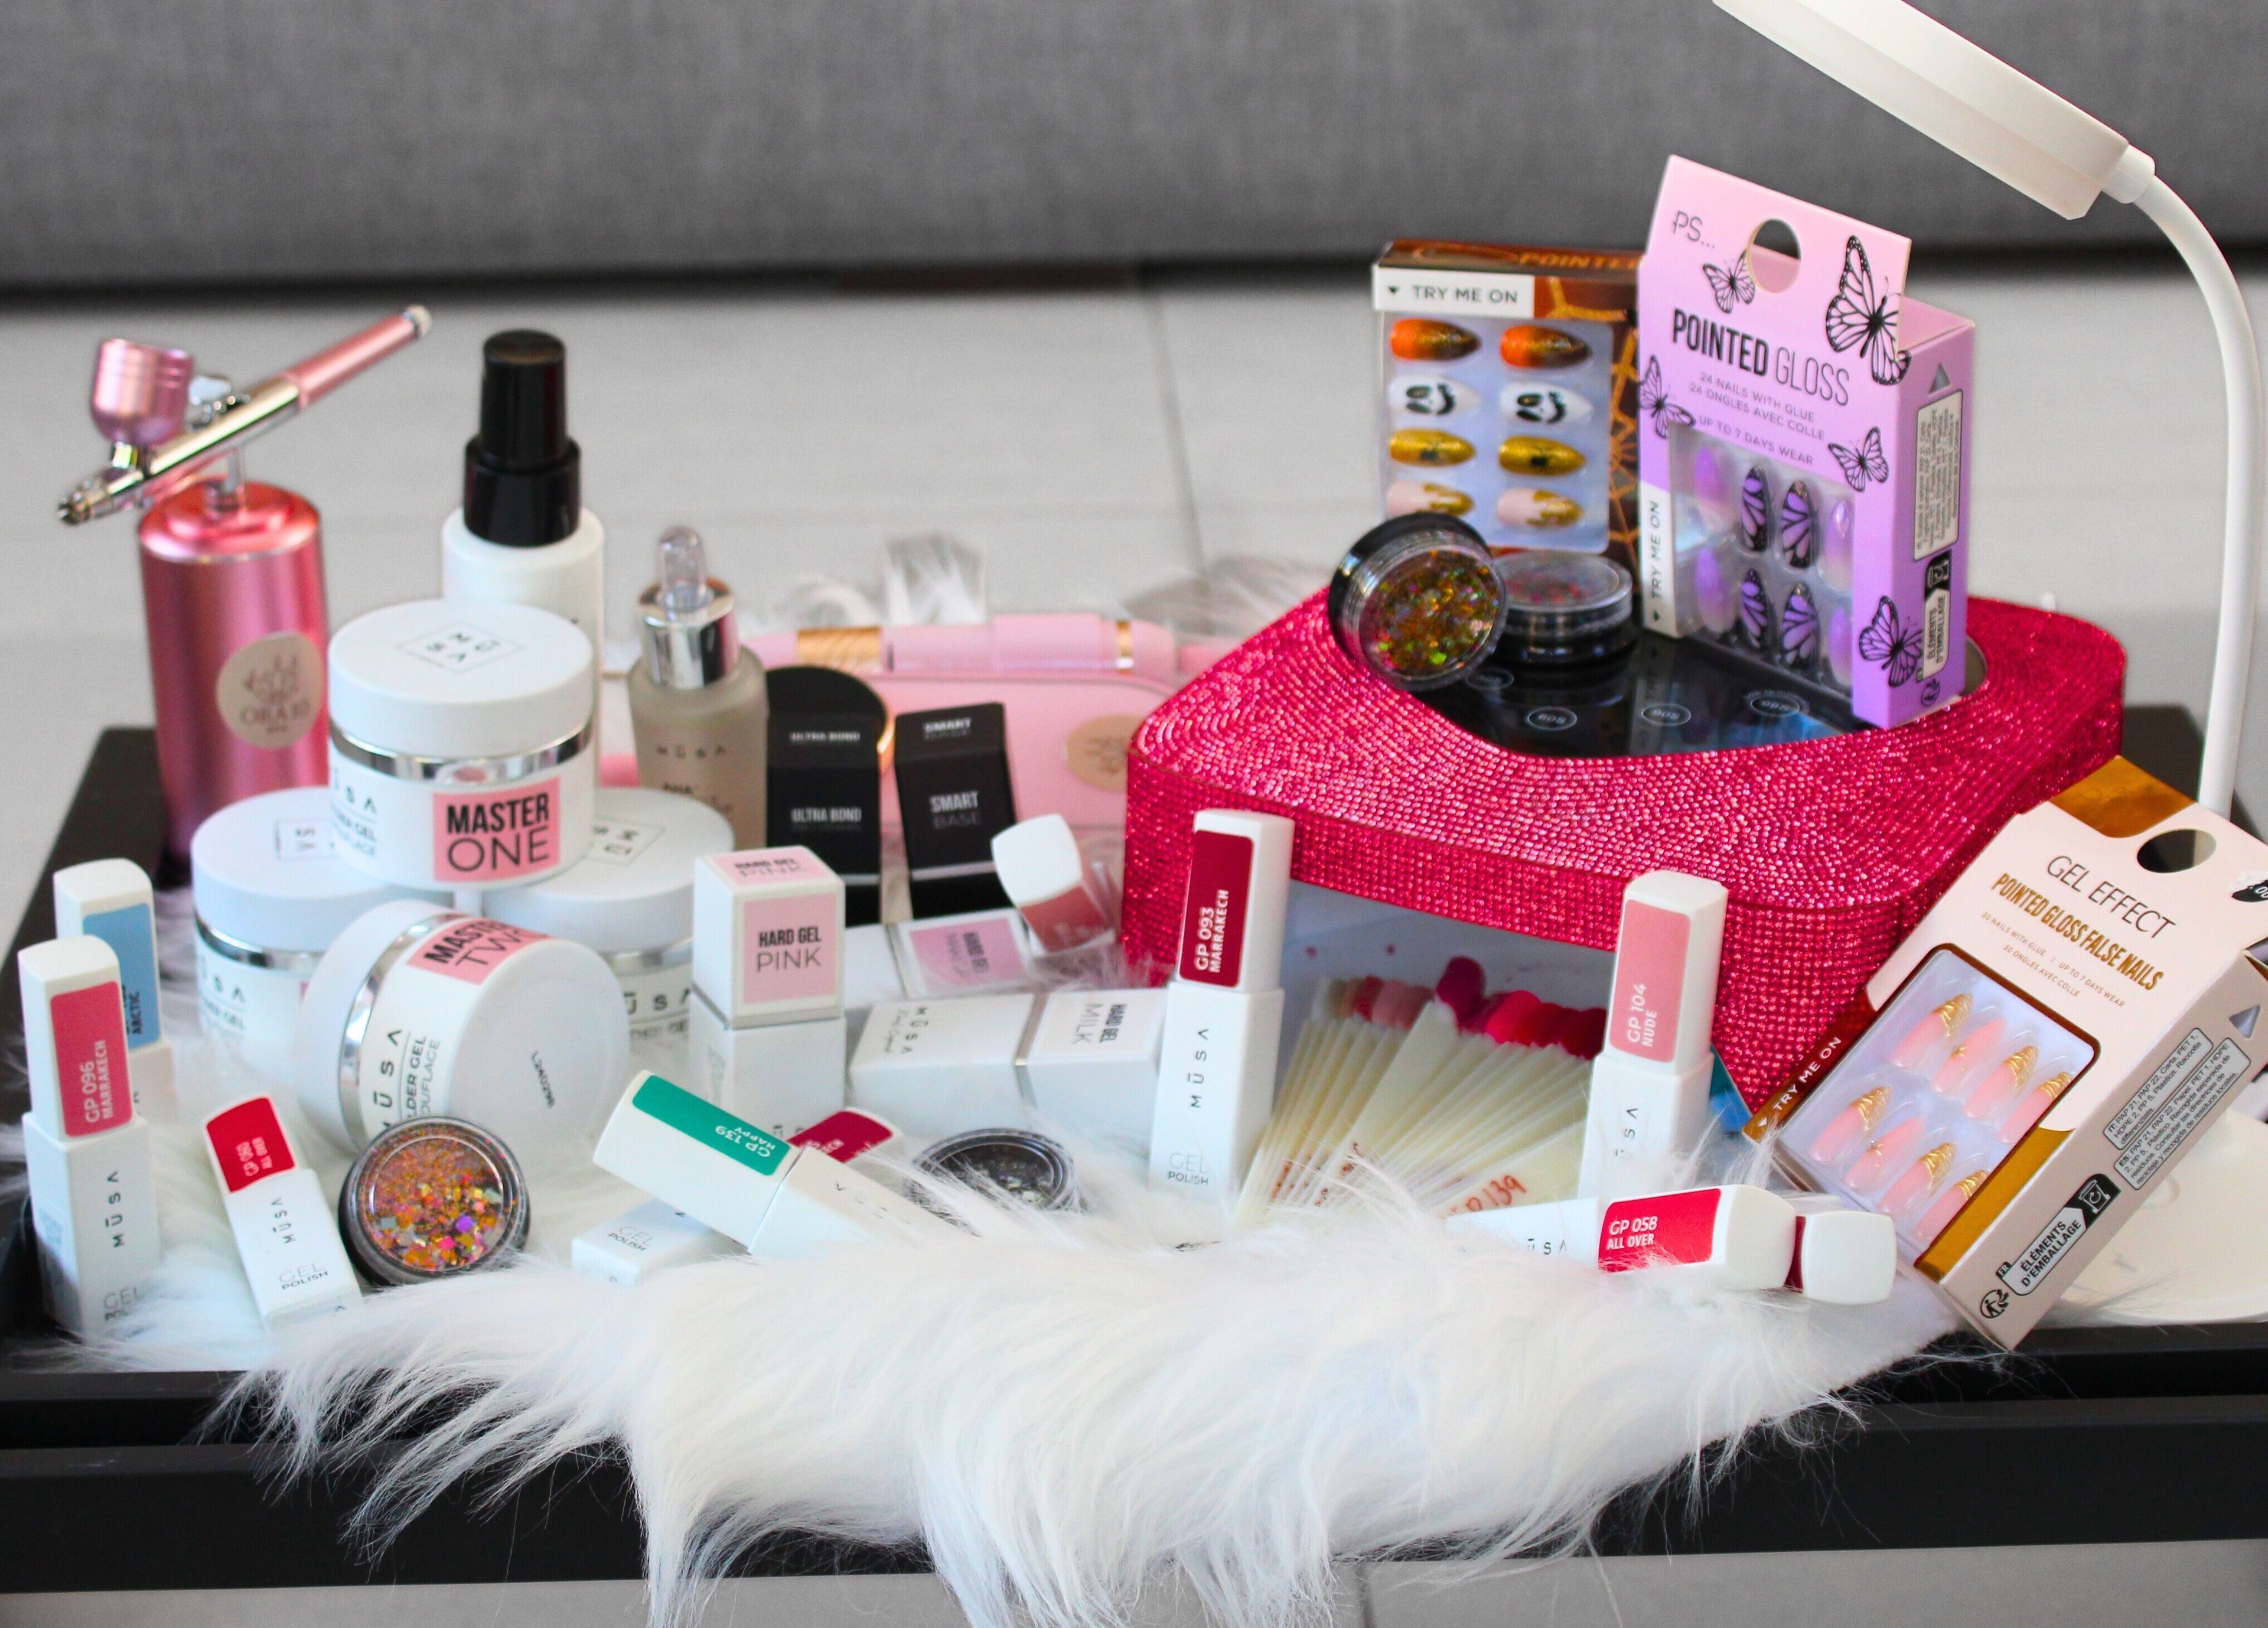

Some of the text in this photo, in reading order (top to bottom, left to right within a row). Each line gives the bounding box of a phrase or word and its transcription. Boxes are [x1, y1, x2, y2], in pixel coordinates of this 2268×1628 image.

[1413, 285, 1518, 304] TRY ME ON
[1673, 308, 1849, 406] POINTED GLOSS
[1690, 383, 1824, 440] 24 ONGLES AVEC COLLE
[1701, 372, 1815, 422] 24 NAILS WITH GLUE
[1700, 415, 1813, 465] UP TO 7 DAYS WEAR
[1650, 500, 1662, 598] TRY ME ON
[923, 718, 972, 733] SMART
[447, 793, 549, 834] MASTER
[790, 807, 862, 823] ULTRA BOND
[930, 790, 979, 813] SMART
[448, 825, 550, 871] ONE
[2047, 855, 2176, 939] GEL EFFECT
[758, 926, 822, 948] HARD GEL
[1194, 906, 1214, 971] GP 093
[1208, 888, 1229, 973] MARRAKECH
[1992, 872, 2164, 991] POINTED GLOSS FALSE NAILS
[757, 946, 822, 973] PINK
[1982, 912, 1992, 920] 30
[1992, 915, 2009, 934] NAILS
[2011, 930, 2028, 945] WITH
[2028, 942, 2047, 956] GLUE
[2059, 962, 2070, 971] UP
[2070, 968, 2080, 978] TO
[2085, 979, 2104, 994] DAYS
[2104, 991, 2125, 1008] WEAR
[2003, 945, 2081, 997] 30 ONGLES AVEC COLLE
[1627, 983, 1647, 1043] GP 104
[1641, 1010, 1658, 1047] NUDE
[410, 1036, 426, 1069] GEL
[1773, 1037, 1842, 1111] TRY ME ON
[79, 1060, 100, 1123] GP 096
[2114, 1117, 2133, 1139] HDPE
[2137, 1099, 2149, 1111] PP
[2175, 1040, 2202, 1069] Raccolta
[2115, 1108, 2130, 1124] PAP
[2137, 1083, 2152, 1099] PAP
[2176, 1040, 2191, 1056] PET
[2130, 1139, 2144, 1154] PAP
[2152, 1114, 2166, 1129] PAP
[2191, 1070, 2205, 1085] PET
[2210, 1043, 2229, 1064] HDPE
[2130, 1154, 2142, 1165] PP
[2170, 1091, 2198, 1122] Recogida
[2195, 1063, 2223, 1093] separada
[2220, 1054, 2231, 1064] de
[2154, 1121, 2182, 1151] Consultar
[2179, 1111, 2191, 1122] las
[2188, 1081, 2217, 1113] directrices
[2215, 1072, 2225, 1082] de
[2162, 1128, 2188, 1155] recogida
[2193, 1093, 2218, 1120] residuos
[715, 1125, 771, 1158] GP 139
[734, 1126, 776, 1151] HAPPY
[1170, 1152, 1208, 1174] GEL
[1168, 1171, 1210, 1186] POLISH
[608, 1232, 647, 1252] POLISH
[1606, 1233, 1655, 1251] ALL OVER
[1609, 1216, 1658, 1236] GP 058
[2021, 1221, 2067, 1272] ÉLÉMENTS
[279, 1262, 325, 1283] GEL
[2021, 1219, 2081, 1288] D'EMBALLAGE
[282, 1271, 328, 1291] POLISH
